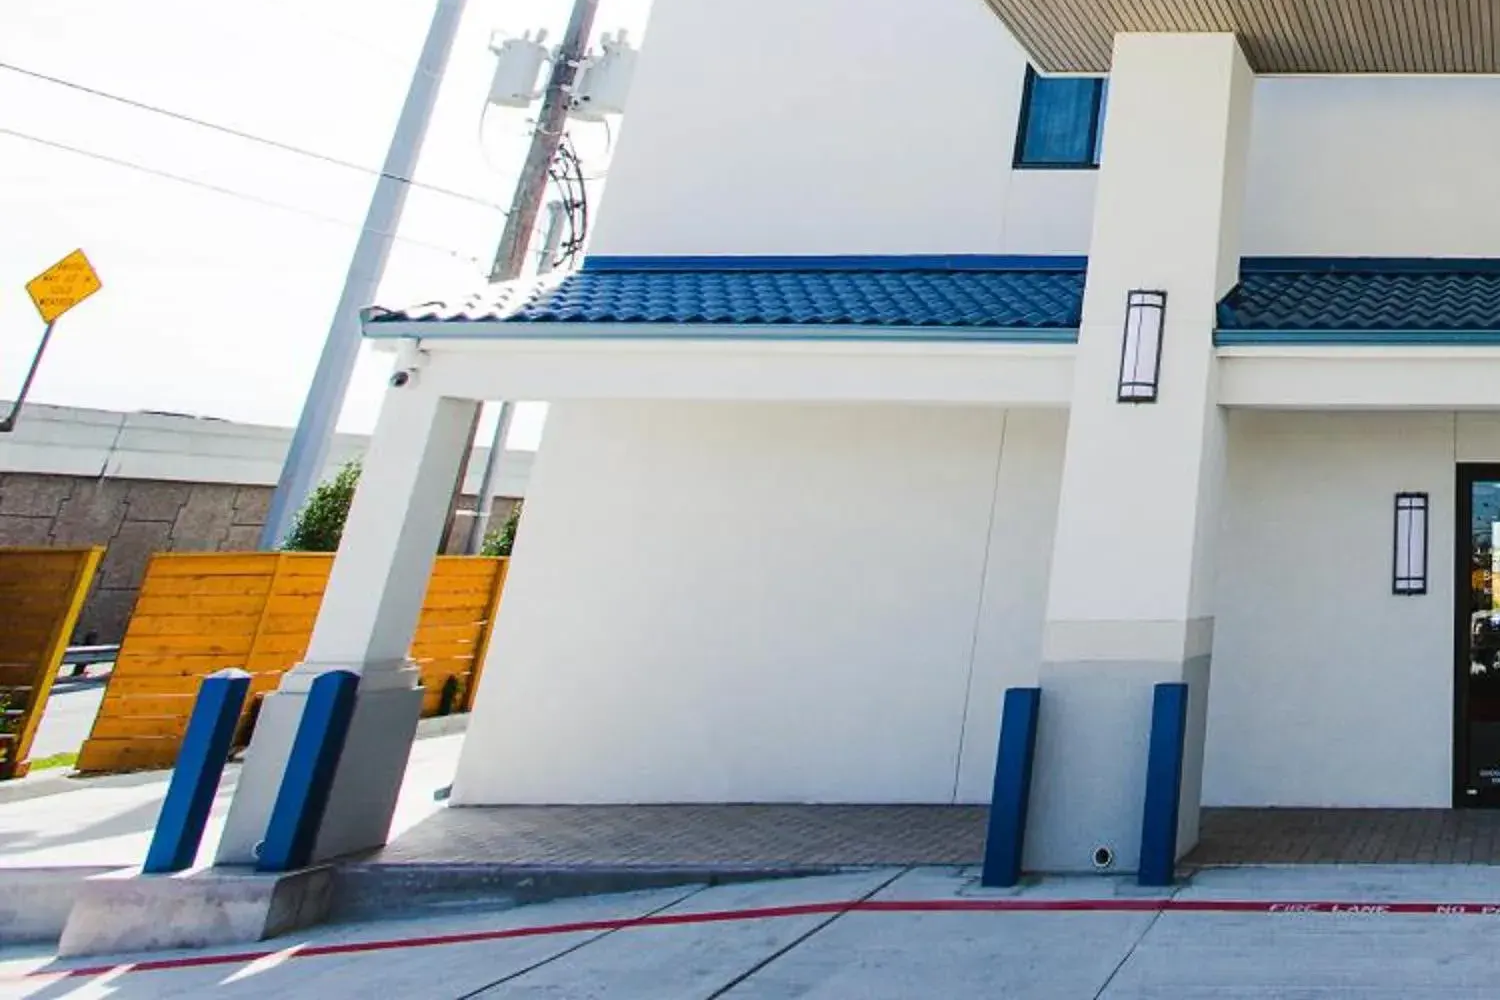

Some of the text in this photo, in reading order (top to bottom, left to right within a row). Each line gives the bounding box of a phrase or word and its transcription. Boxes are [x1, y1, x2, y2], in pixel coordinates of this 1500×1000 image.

[1269, 903, 1319, 915] FIRE
[1331, 904, 1392, 915] LANE
[1436, 904, 1465, 915] NO
